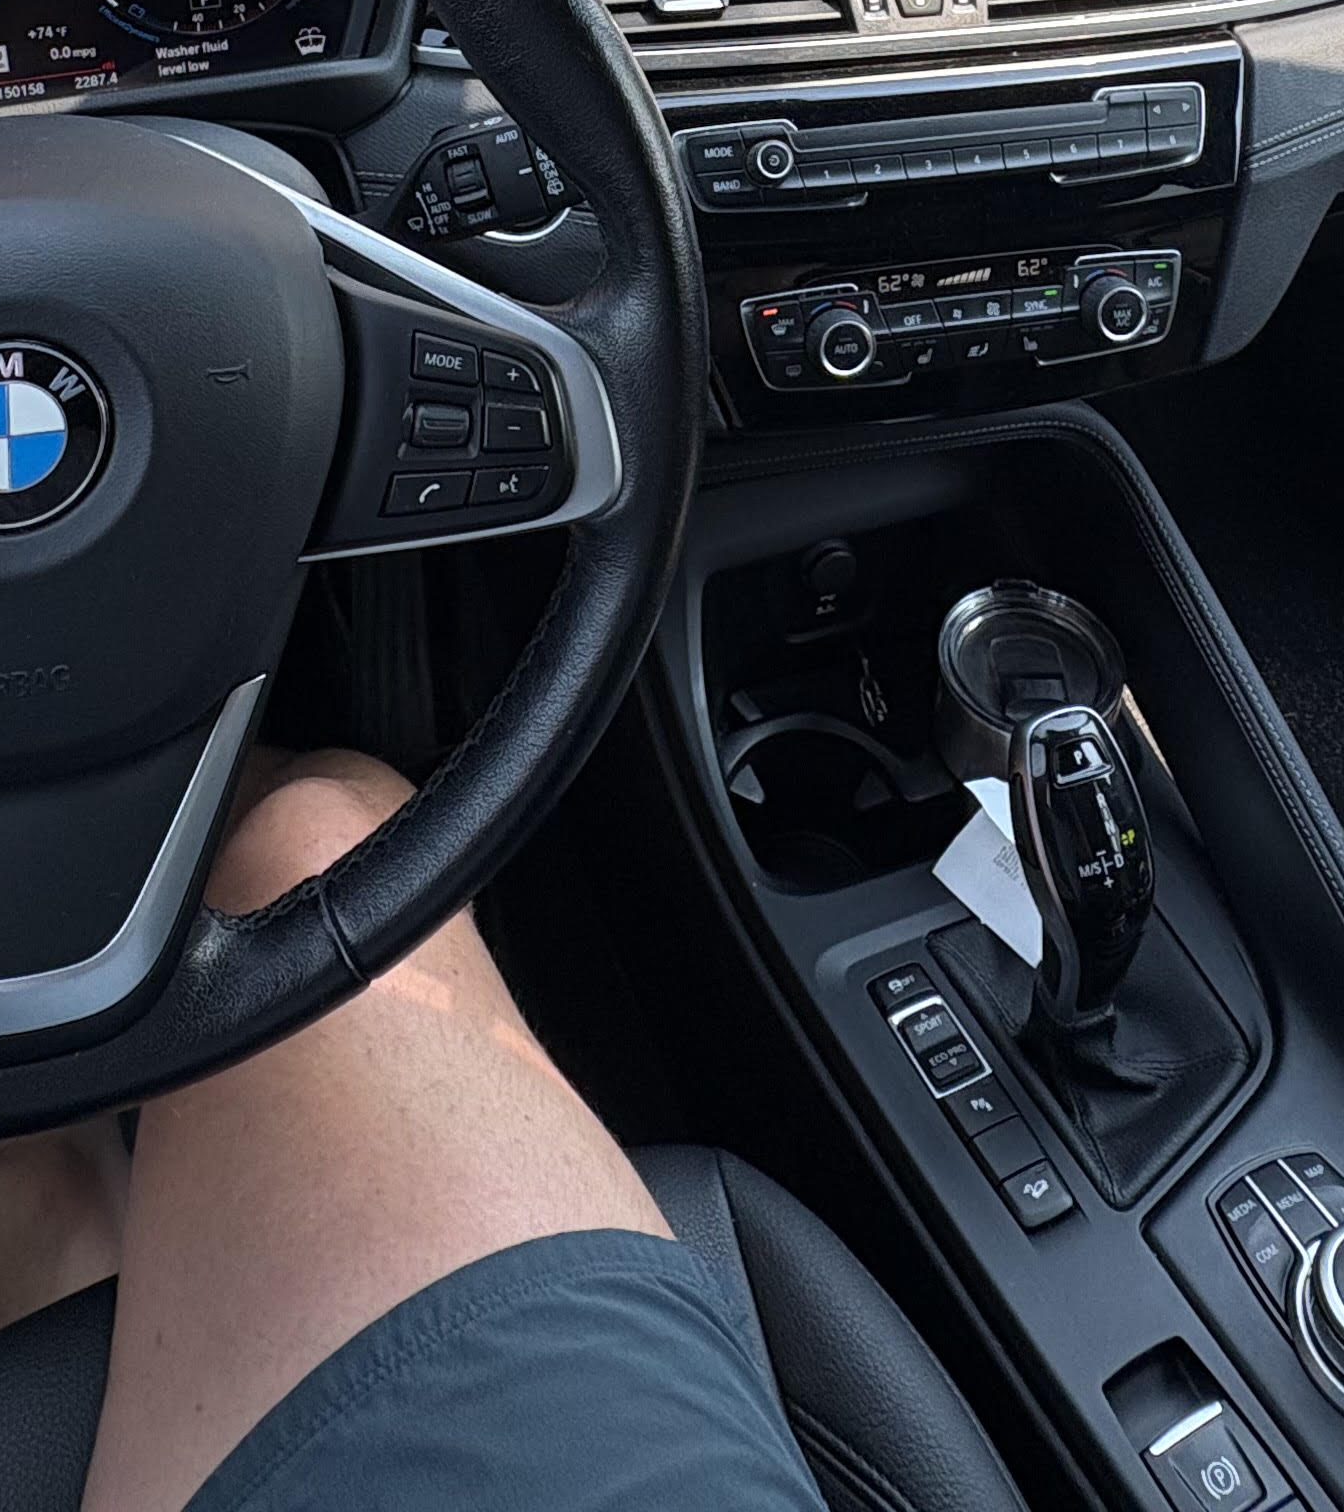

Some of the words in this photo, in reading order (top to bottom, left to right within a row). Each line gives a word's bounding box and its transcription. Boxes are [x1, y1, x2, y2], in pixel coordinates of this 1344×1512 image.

[192, 14, 203, 22] 40
[50, 46, 71, 59] 0.0
[73, 47, 96, 59] mpg
[156, 44, 200, 60] Washer
[202, 39, 229, 52] fluid
[158, 62, 185, 77] level
[188, 59, 210, 73] low
[74, 71, 118, 90] 2287.4
[495, 130, 518, 144] AUTO
[448, 145, 468, 159] FAST
[704, 146, 734, 159] MODE
[713, 179, 740, 193] BAND
[430, 201, 452, 214] AUTO
[434, 214, 449, 225] OFF
[467, 209, 492, 225] SLOW
[1024, 300, 1048, 312] SYNC
[903, 314, 922, 326] OFF
[1113, 309, 1132, 319] MAX
[834, 343, 858, 355] AUTO
[424, 351, 464, 370] MODE
[1073, 750, 1083, 765] P
[1114, 853, 1124, 868] D
[1078, 861, 1102, 878] M/S
[914, 1015, 943, 1036] SPORT
[928, 1052, 949, 1067] ECO
[948, 1043, 967, 1057] PRO
[1304, 1164, 1325, 1179] MAP
[1276, 1191, 1304, 1210] MENU
[1227, 1199, 1257, 1222] MEDIA
[1256, 1243, 1280, 1264] COM
